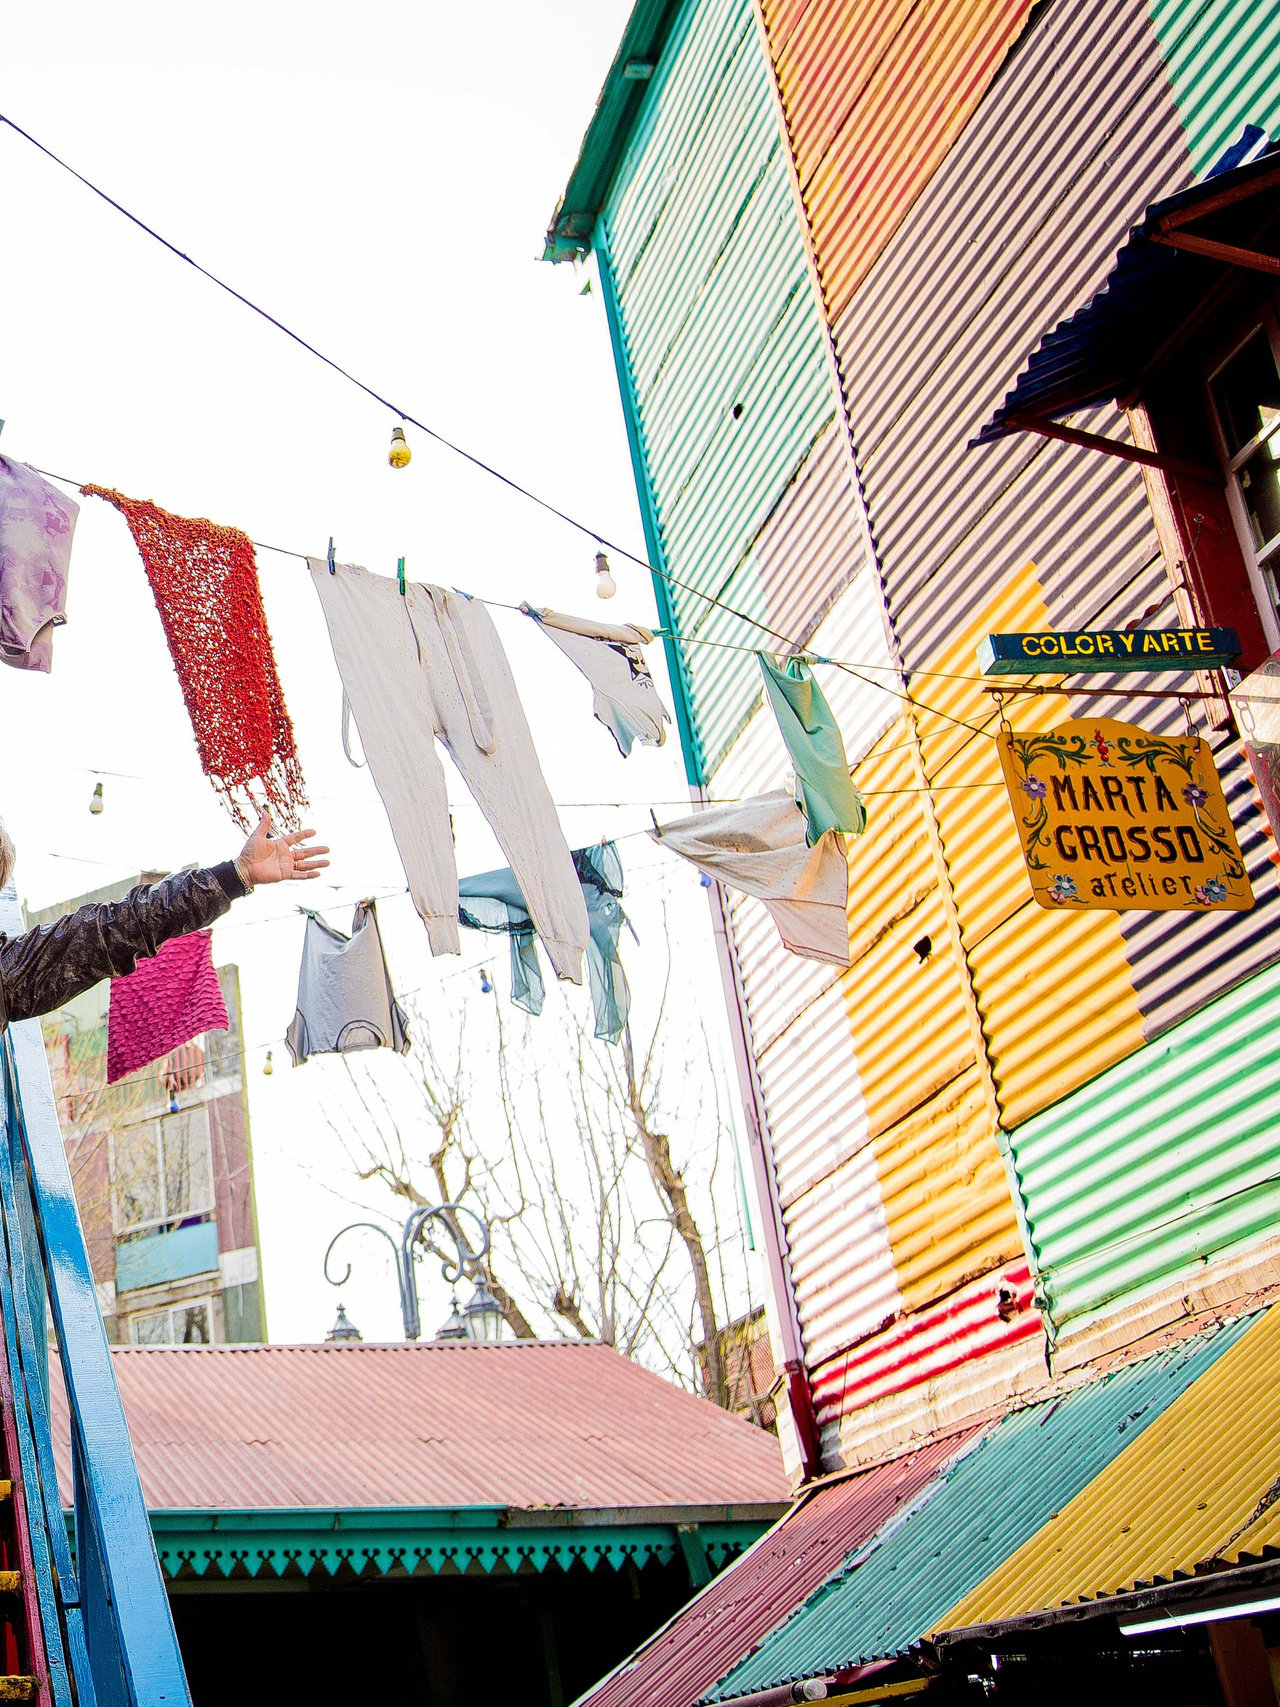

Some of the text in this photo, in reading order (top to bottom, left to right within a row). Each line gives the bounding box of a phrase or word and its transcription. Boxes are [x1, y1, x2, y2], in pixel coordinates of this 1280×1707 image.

[1022, 631, 1215, 656] COLOR Y ARTE
[1051, 775, 1178, 818] MARTA
[1054, 825, 1204, 868] GROSSO
[1090, 873, 1196, 898] atelier
